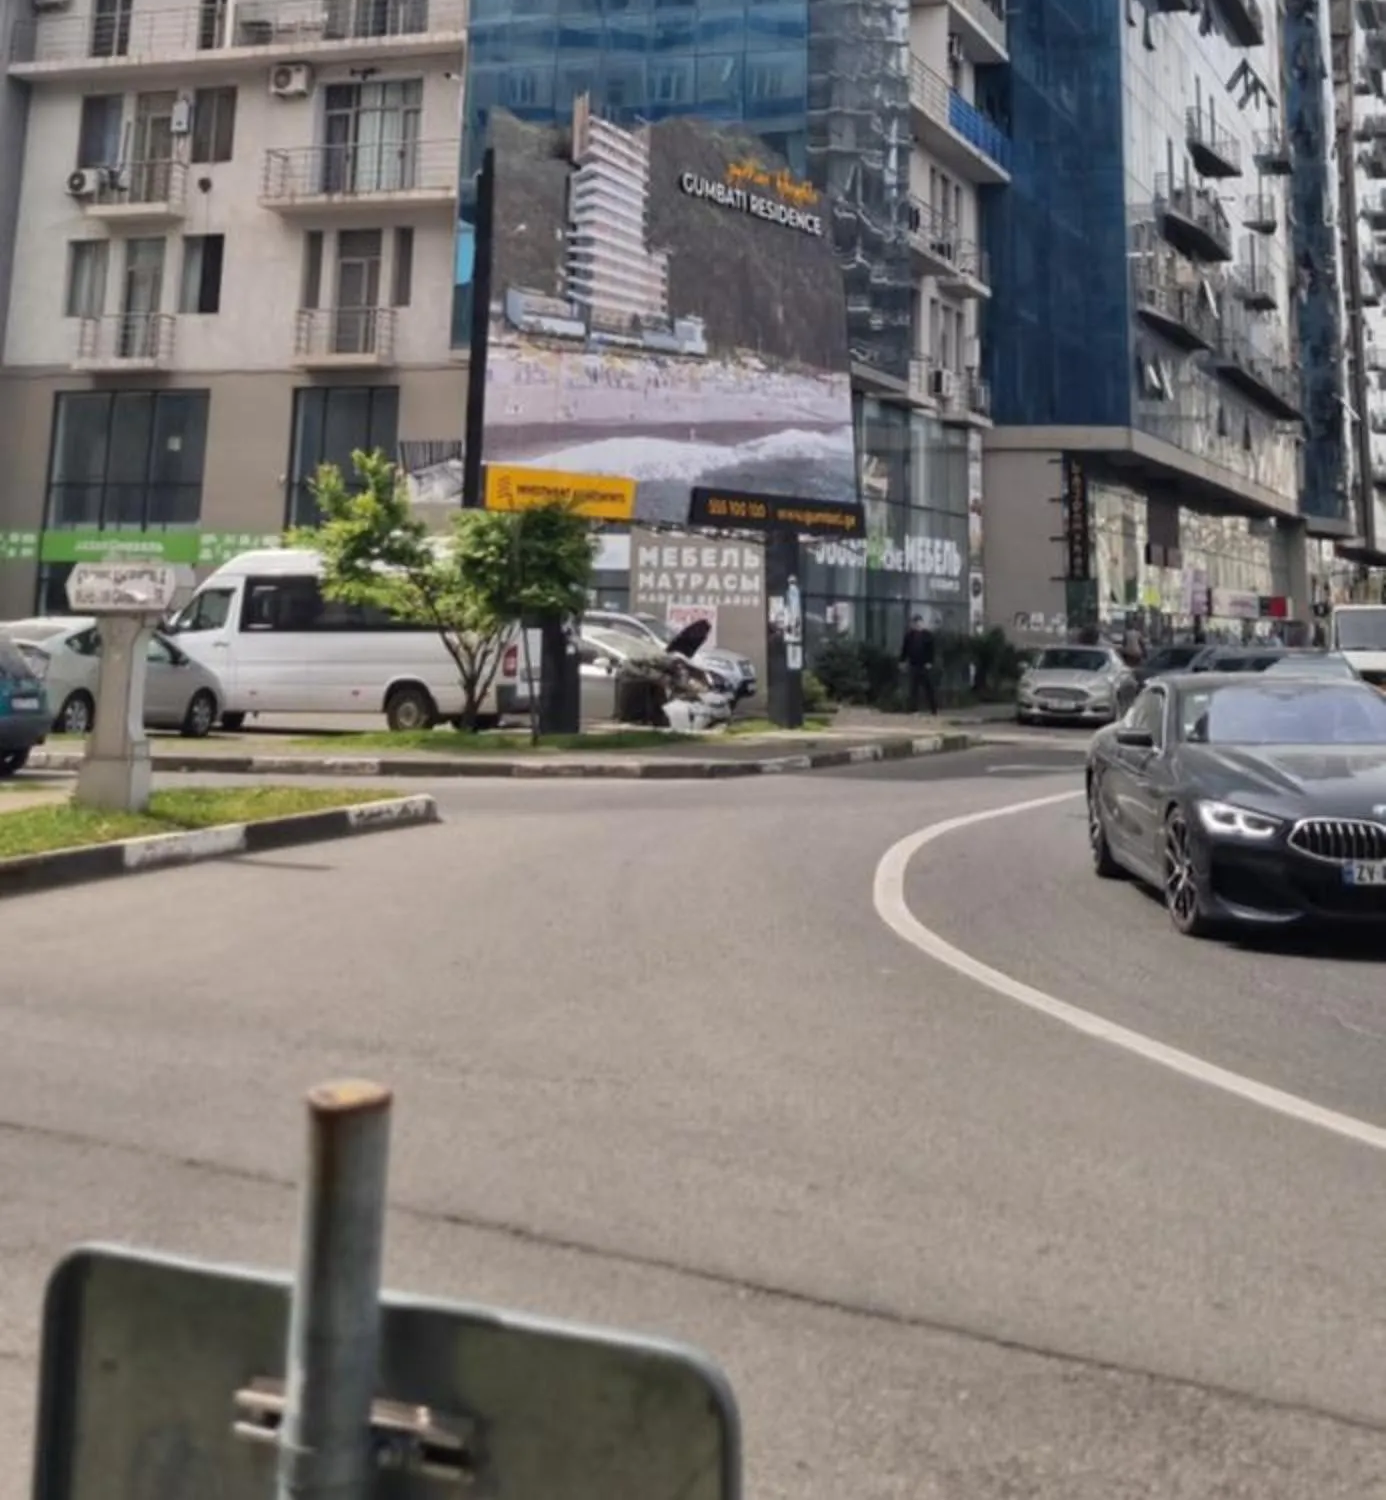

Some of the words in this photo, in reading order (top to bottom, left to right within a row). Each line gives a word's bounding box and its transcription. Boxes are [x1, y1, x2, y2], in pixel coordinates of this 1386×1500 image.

[681, 171, 747, 211] GUMBATI
[750, 194, 823, 236] RESIDENCE
[638, 545, 761, 570] МЕБЕЛЬ
[638, 571, 761, 592] МАТРАСЫ
